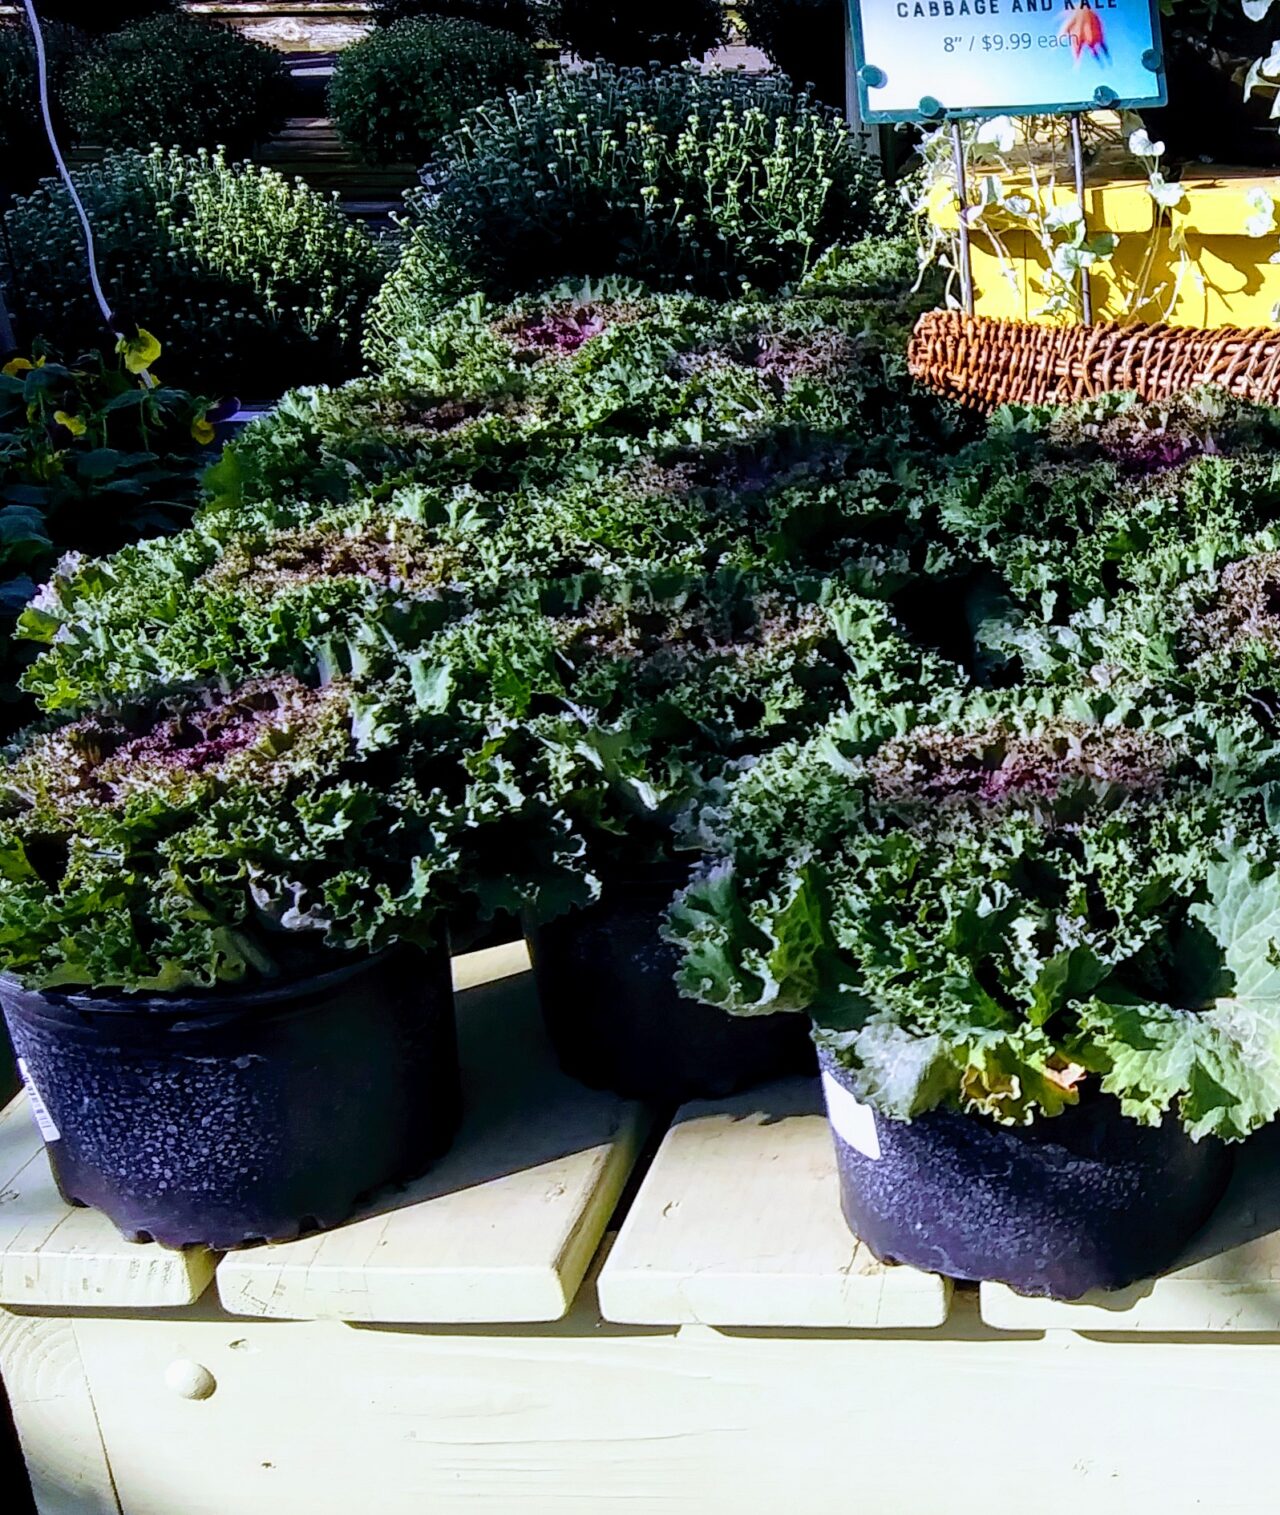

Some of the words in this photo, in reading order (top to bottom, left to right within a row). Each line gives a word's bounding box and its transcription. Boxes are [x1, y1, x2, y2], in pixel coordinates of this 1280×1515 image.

[896, 0, 1000, 18] CABBAGE
[1011, 0, 1053, 13] AND
[1064, 0, 1118, 10] KALE
[968, 35, 976, 52] /
[981, 33, 1033, 52] $9.99
[1037, 31, 1080, 49] each
